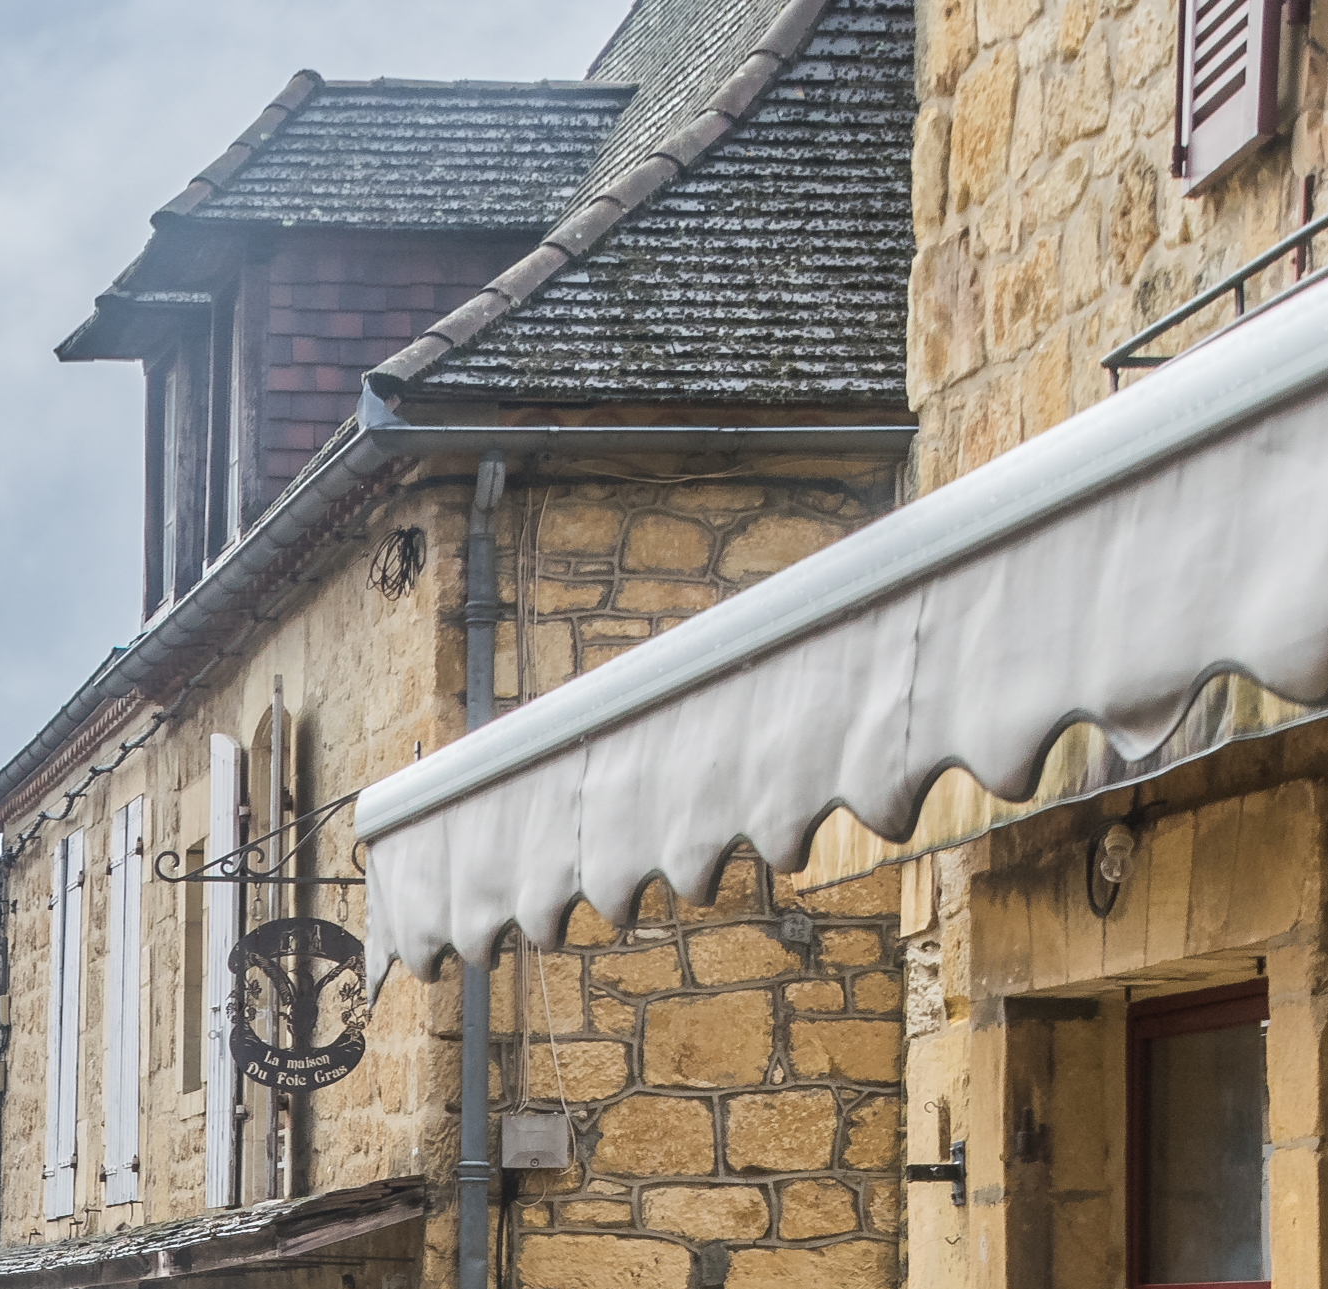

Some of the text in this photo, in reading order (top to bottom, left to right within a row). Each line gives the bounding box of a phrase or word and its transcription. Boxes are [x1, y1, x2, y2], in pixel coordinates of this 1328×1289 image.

[264, 1050, 330, 1070] La maison
[246, 1061, 348, 1086] Du Foie Gras
